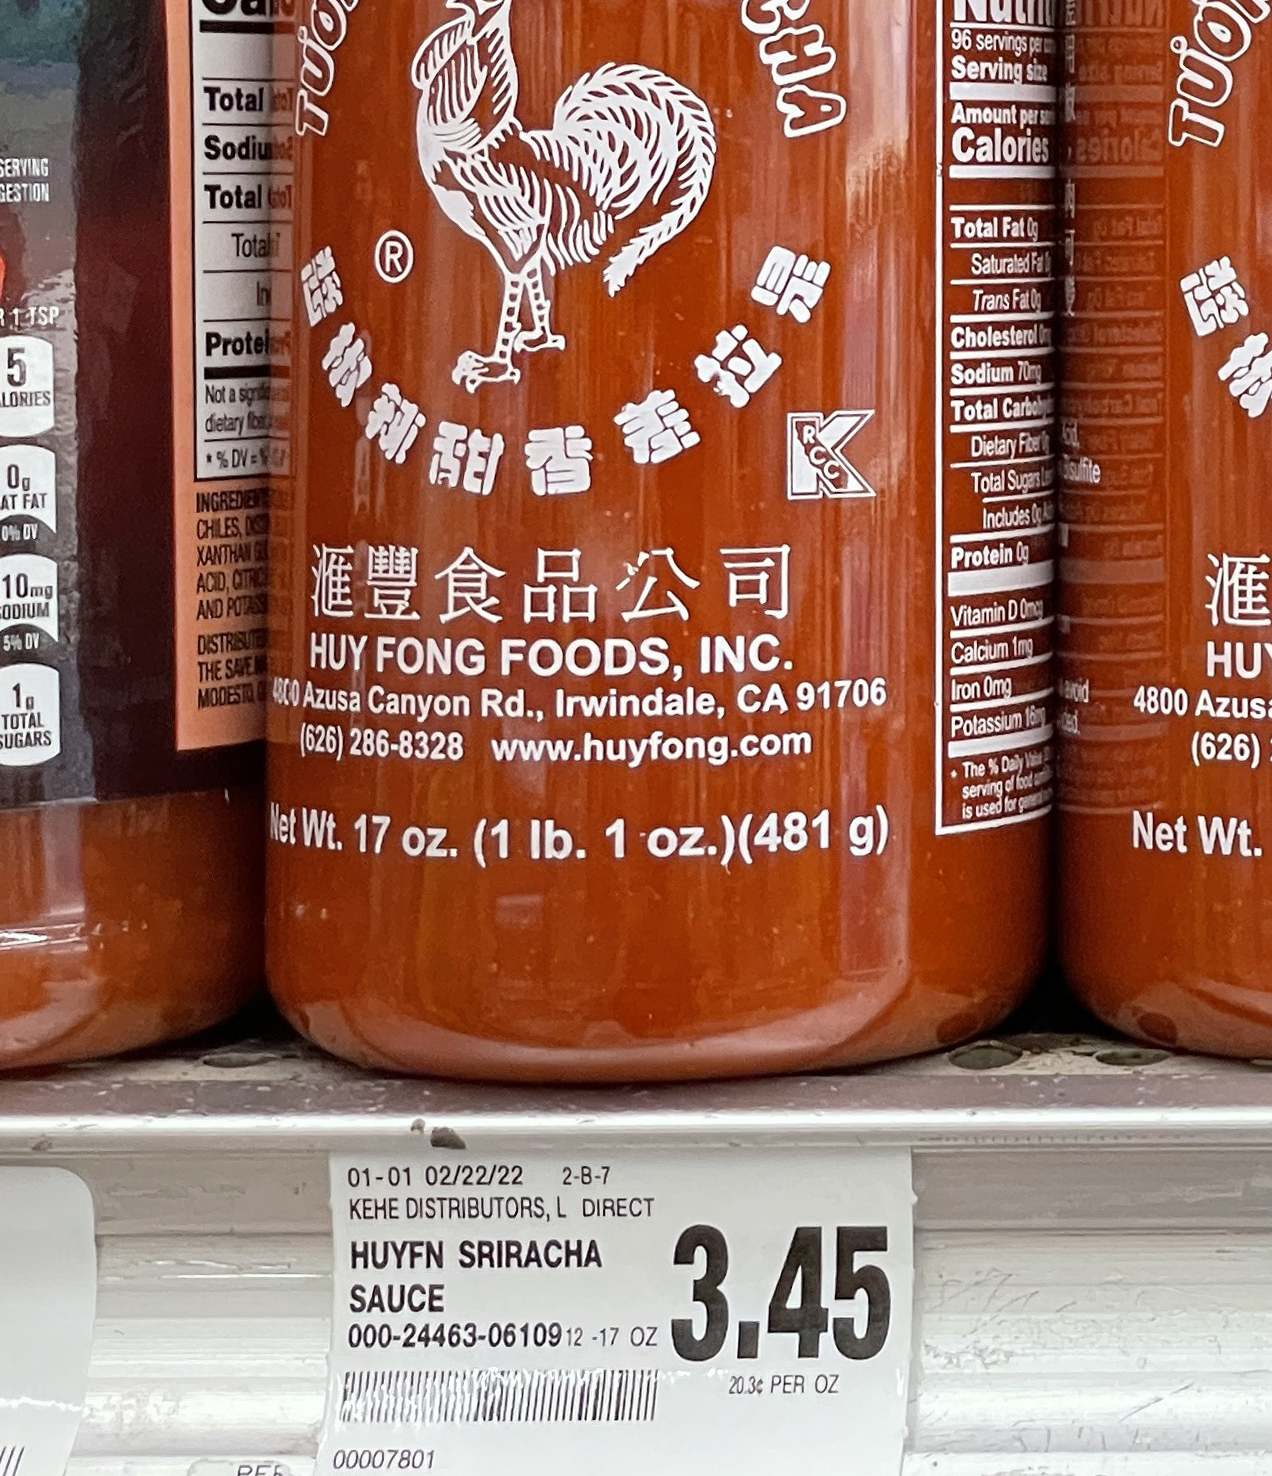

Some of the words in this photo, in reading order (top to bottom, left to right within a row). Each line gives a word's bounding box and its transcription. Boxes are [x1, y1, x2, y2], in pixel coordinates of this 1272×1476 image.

[951, 55, 1022, 84] Serving
[204, 86, 263, 111] Total
[952, 127, 1048, 163] Calories
[28, 307, 59, 325] TSP
[951, 364, 1013, 385] Sodium
[22, 493, 48, 510] FAT
[951, 543, 1012, 570] Protein
[2, 574, 53, 601] 10mg
[310, 633, 369, 673] HUY
[377, 635, 486, 676] FONG
[501, 635, 683, 682] FOODS,
[701, 635, 794, 673] INC.
[951, 679, 980, 701] Iron
[1132, 685, 1189, 716] 4800
[1, 713, 43, 729] TOTAL
[348, 1167, 411, 1186] 01-01
[425, 1165, 523, 1185] 02/22/22
[562, 1166, 610, 1185] 2-B-7
[349, 1197, 398, 1219] KEHE
[406, 1196, 550, 1221] DISTRIBUTORS,
[557, 1196, 566, 1218] L
[582, 1197, 654, 1217] DIRECT
[351, 1240, 444, 1268] HUYFN
[458, 1239, 602, 1268] SRIRACHA
[350, 1284, 444, 1313] SAUCE
[671, 1224, 891, 1361] 3.45
[349, 1322, 562, 1347] 000-24463-06109
[566, 1327, 582, 1346] 12
[592, 1327, 618, 1346] -17
[630, 1327, 658, 1346] OZ
[770, 1375, 805, 1394] PER
[815, 1375, 839, 1394] OZ
[333, 1449, 435, 1469] 00007801
